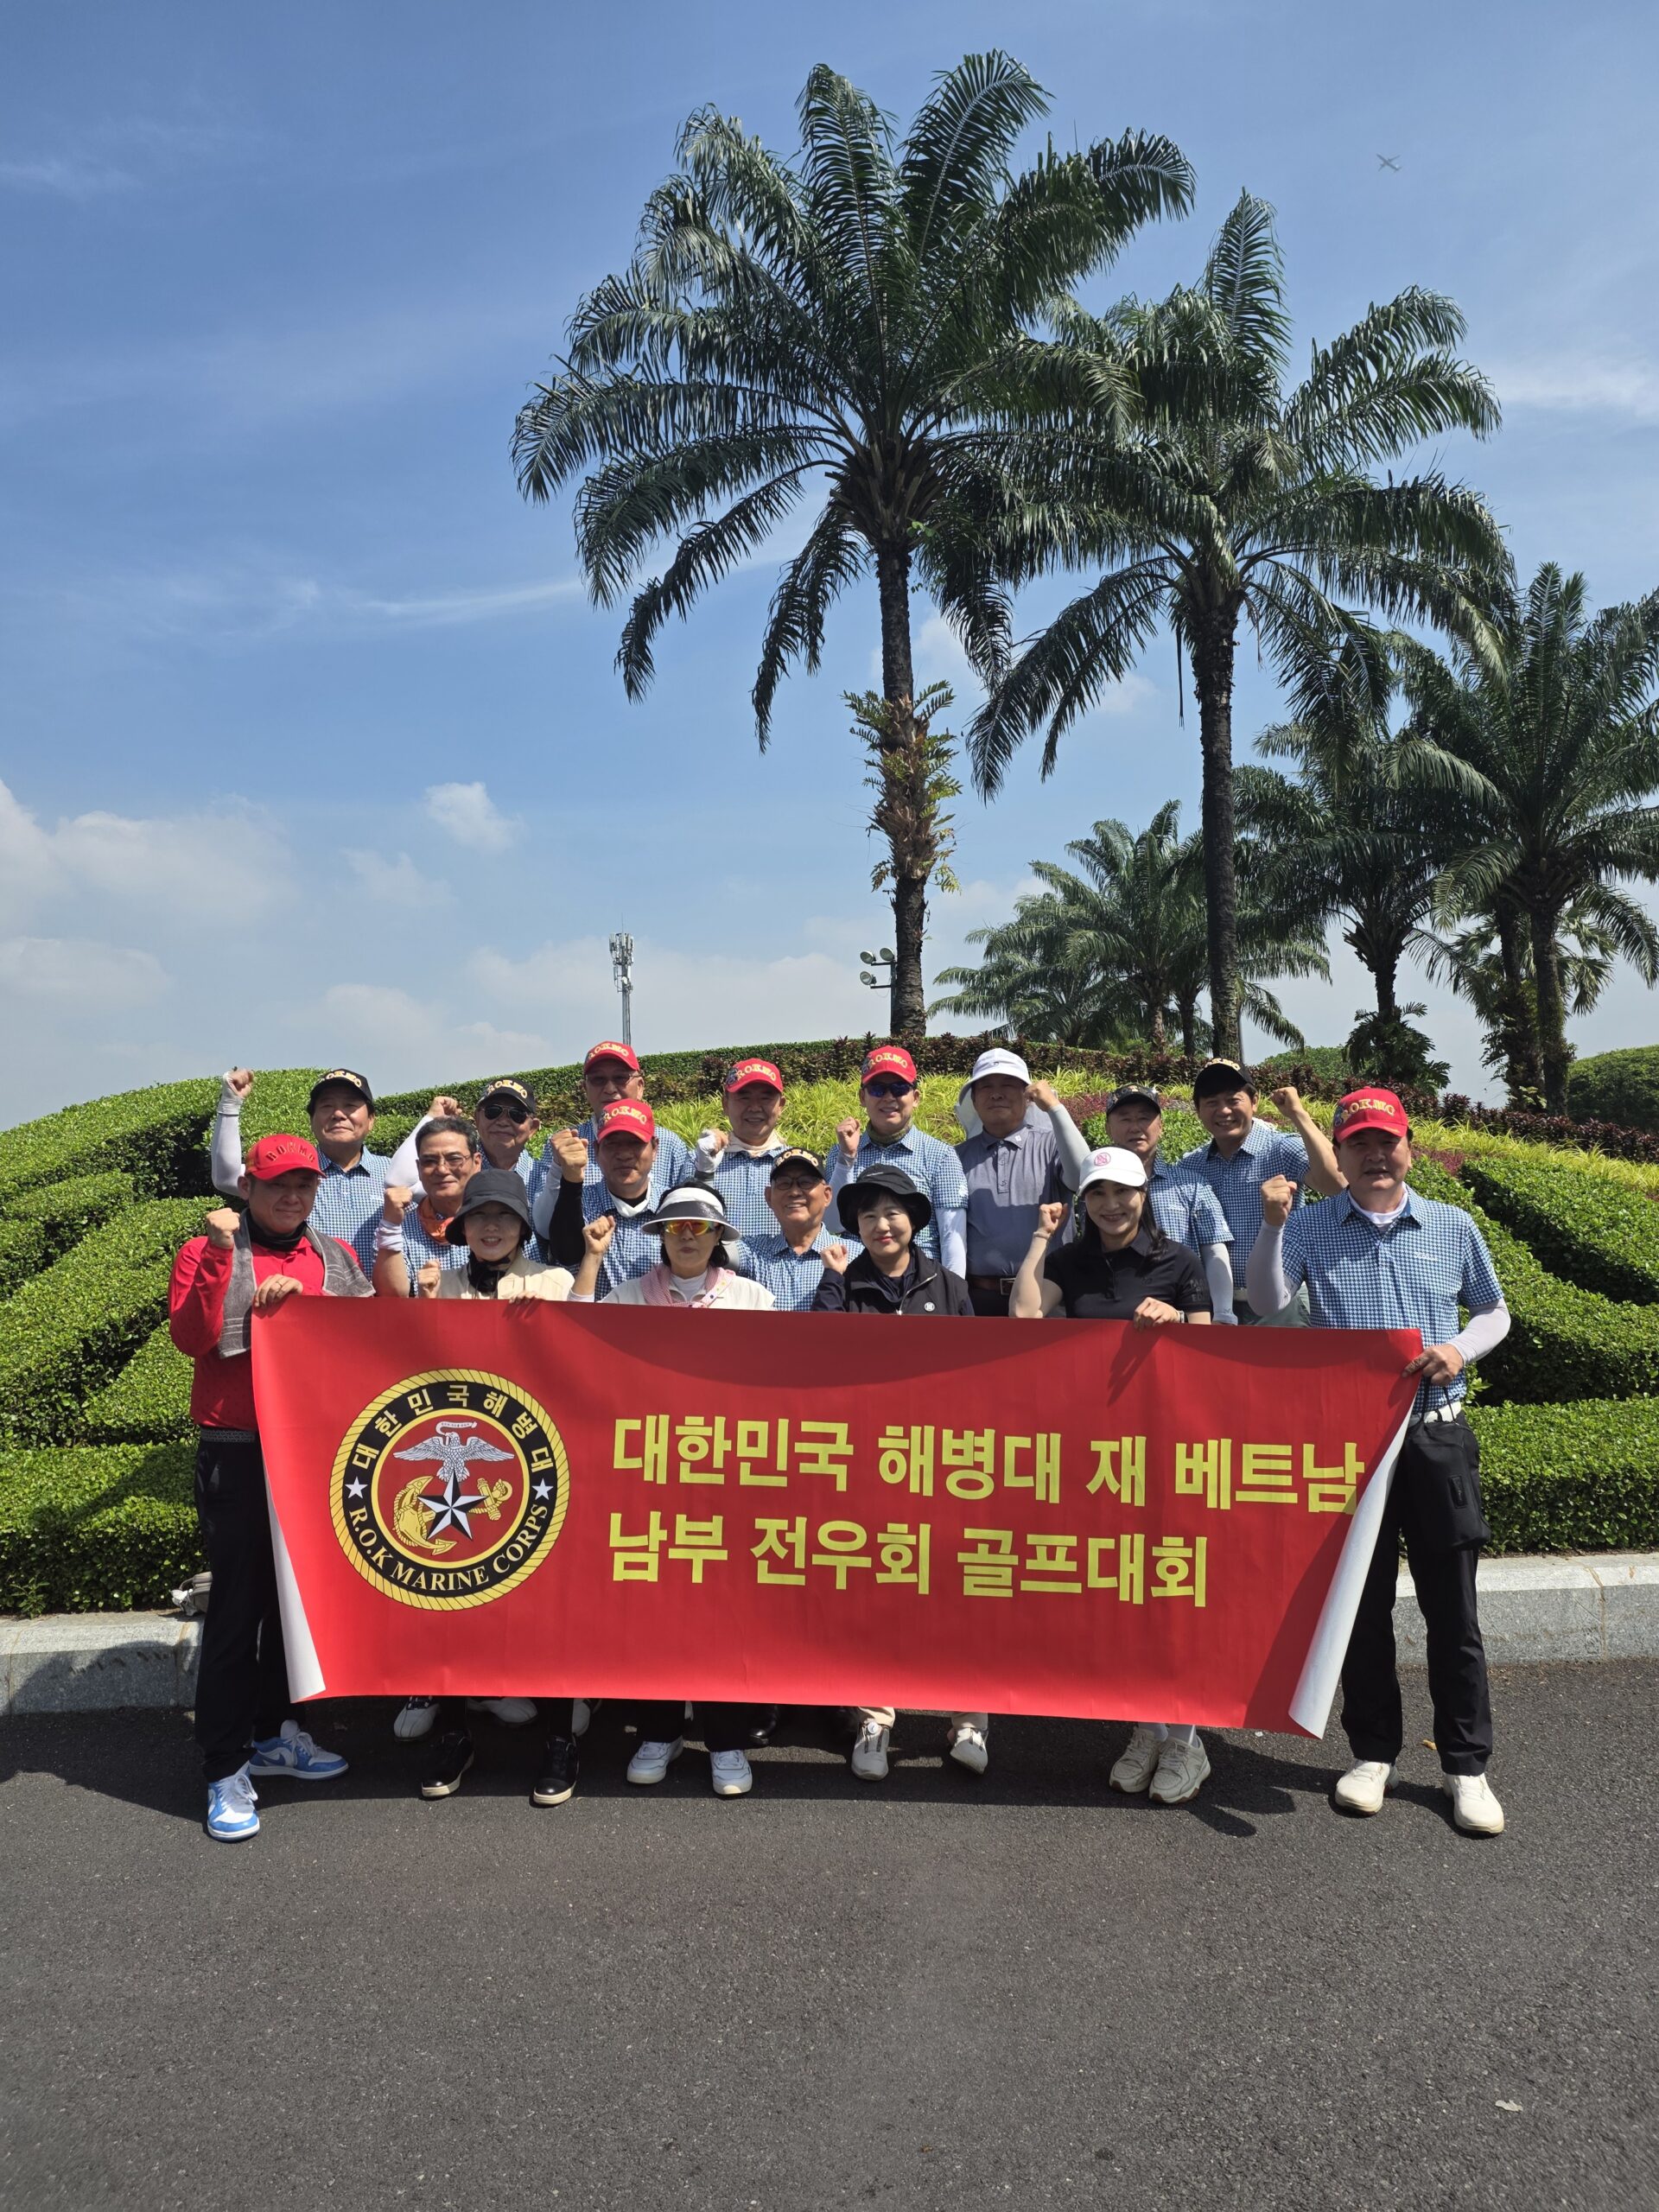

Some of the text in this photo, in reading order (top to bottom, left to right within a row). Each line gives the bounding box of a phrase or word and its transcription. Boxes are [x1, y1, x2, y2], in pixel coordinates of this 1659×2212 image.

[613, 1414, 1365, 1516] 대한민국 해병대 재 베트남
[390, 1560, 489, 1592] MARINE
[493, 1503, 549, 1574] CORPS
[608, 1510, 1208, 1608] 남부 전우회 골프대회
